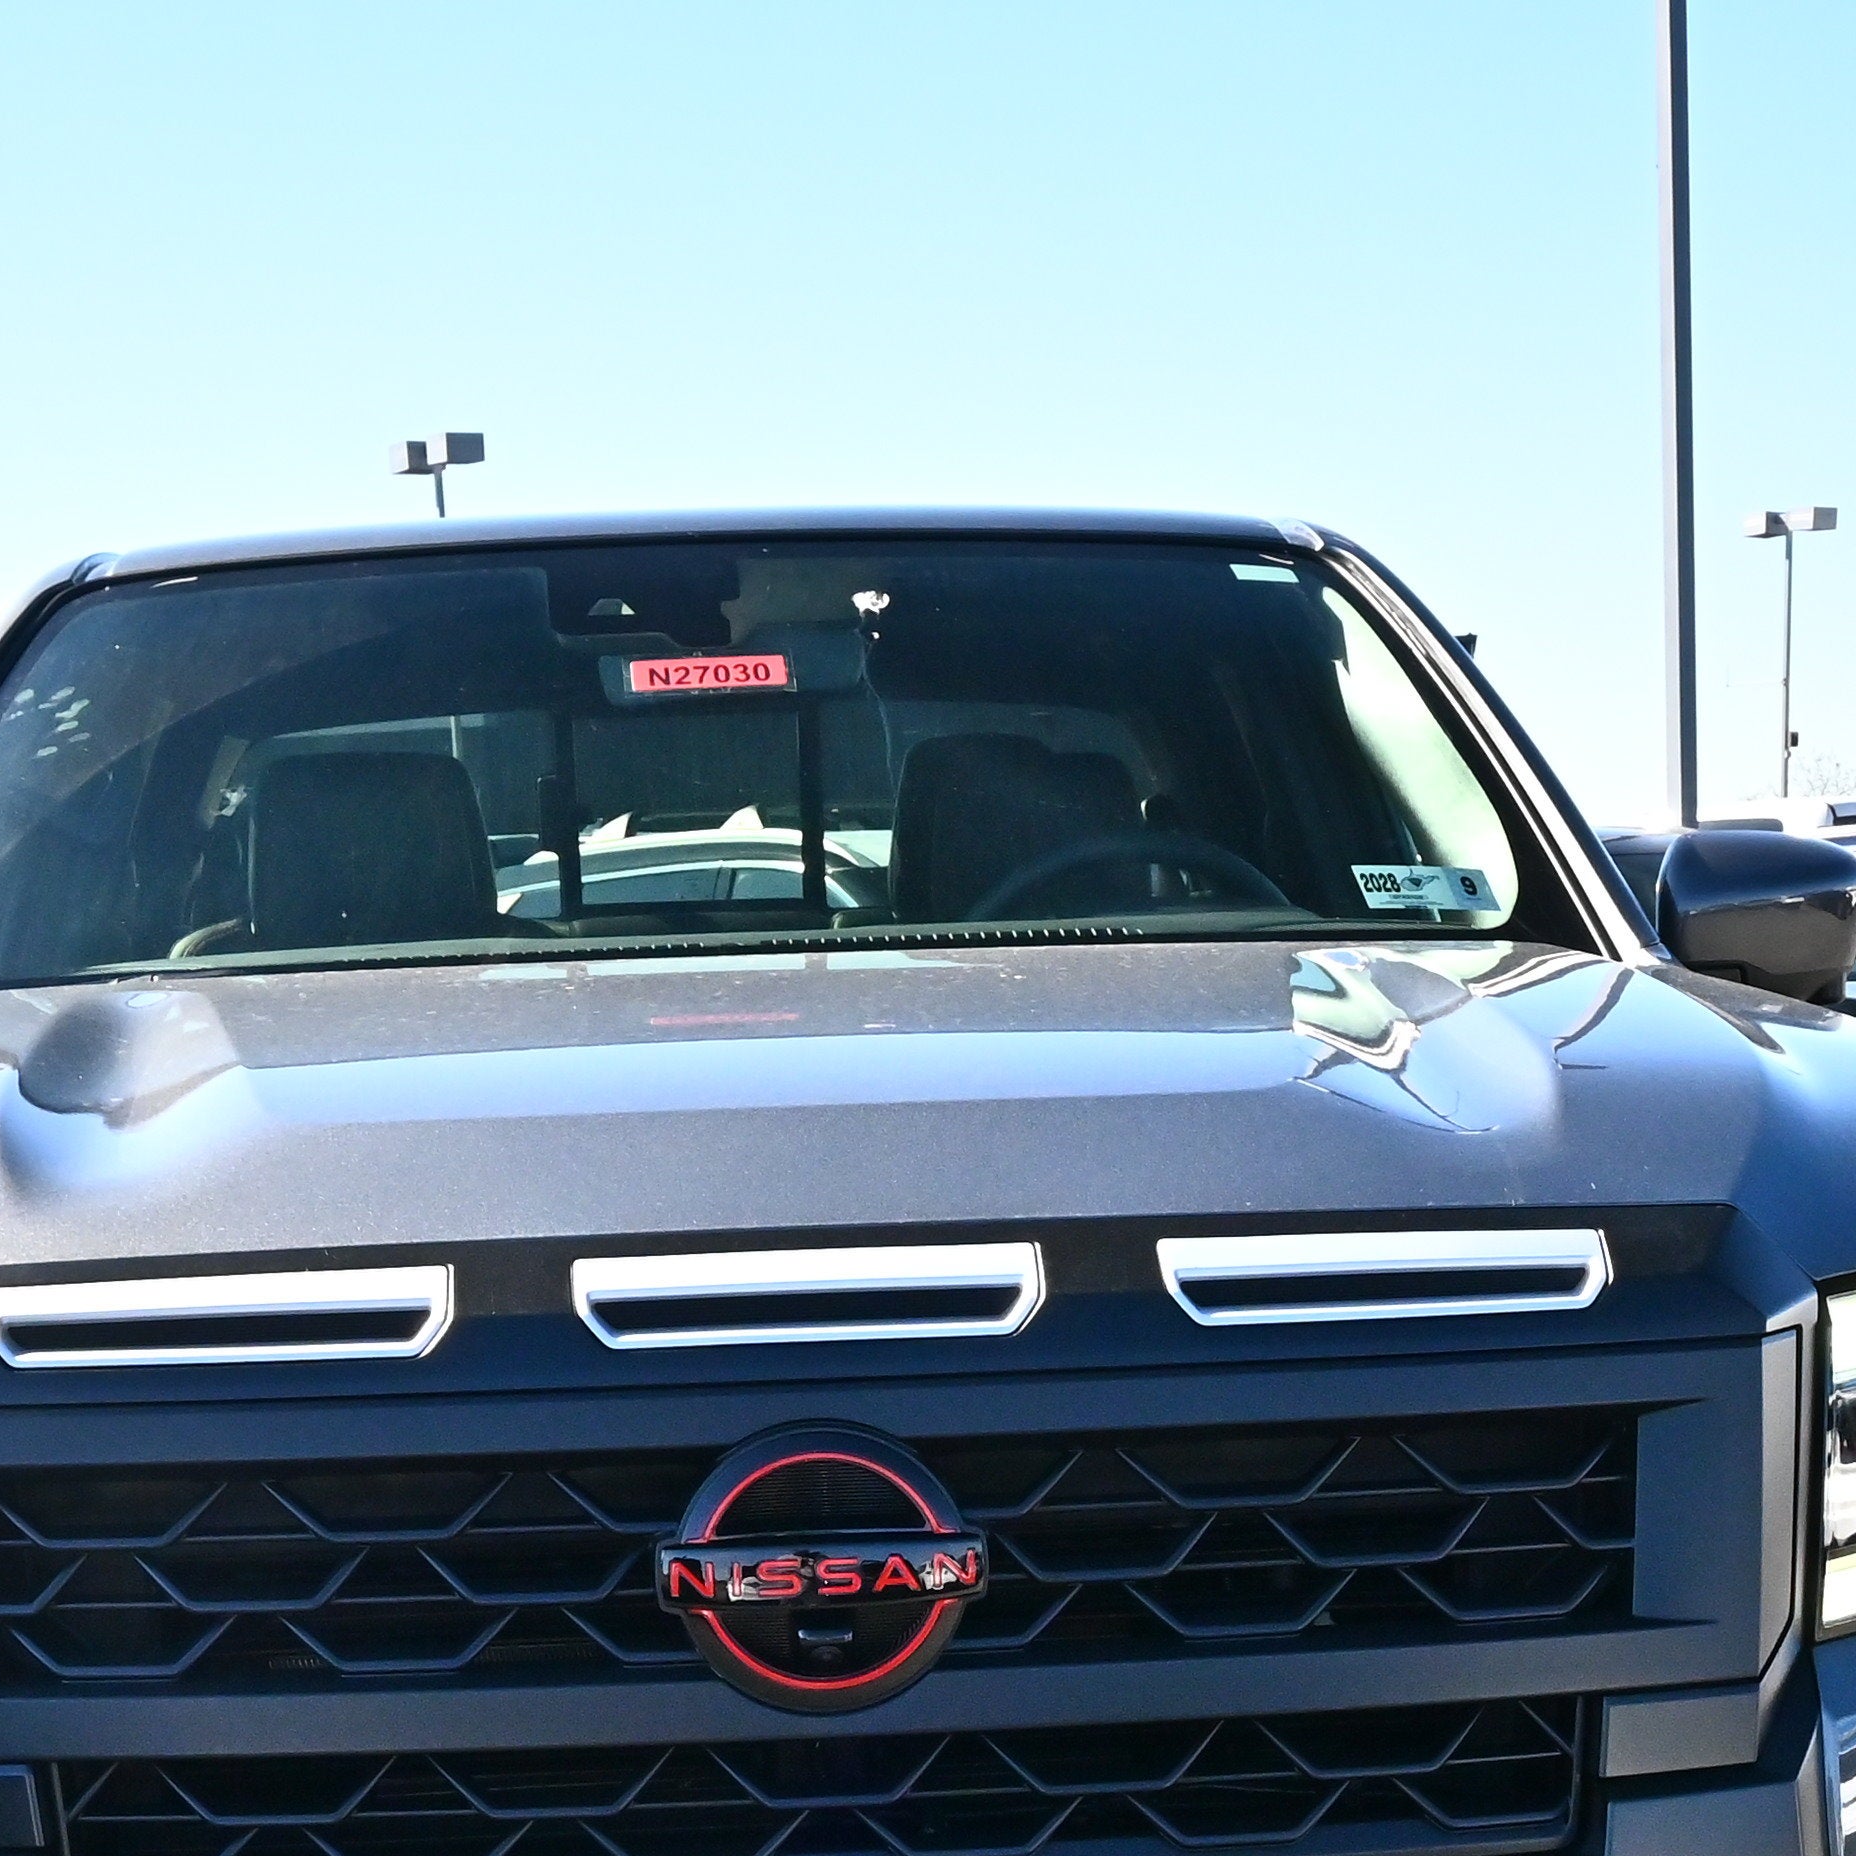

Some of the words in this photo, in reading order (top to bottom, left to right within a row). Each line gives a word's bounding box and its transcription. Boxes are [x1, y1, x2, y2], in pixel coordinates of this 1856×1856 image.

[649, 662, 771, 687] N27030
[1359, 872, 1401, 893] 2028
[1460, 876, 1478, 896] 9
[669, 1548, 978, 1598] NISSAN
